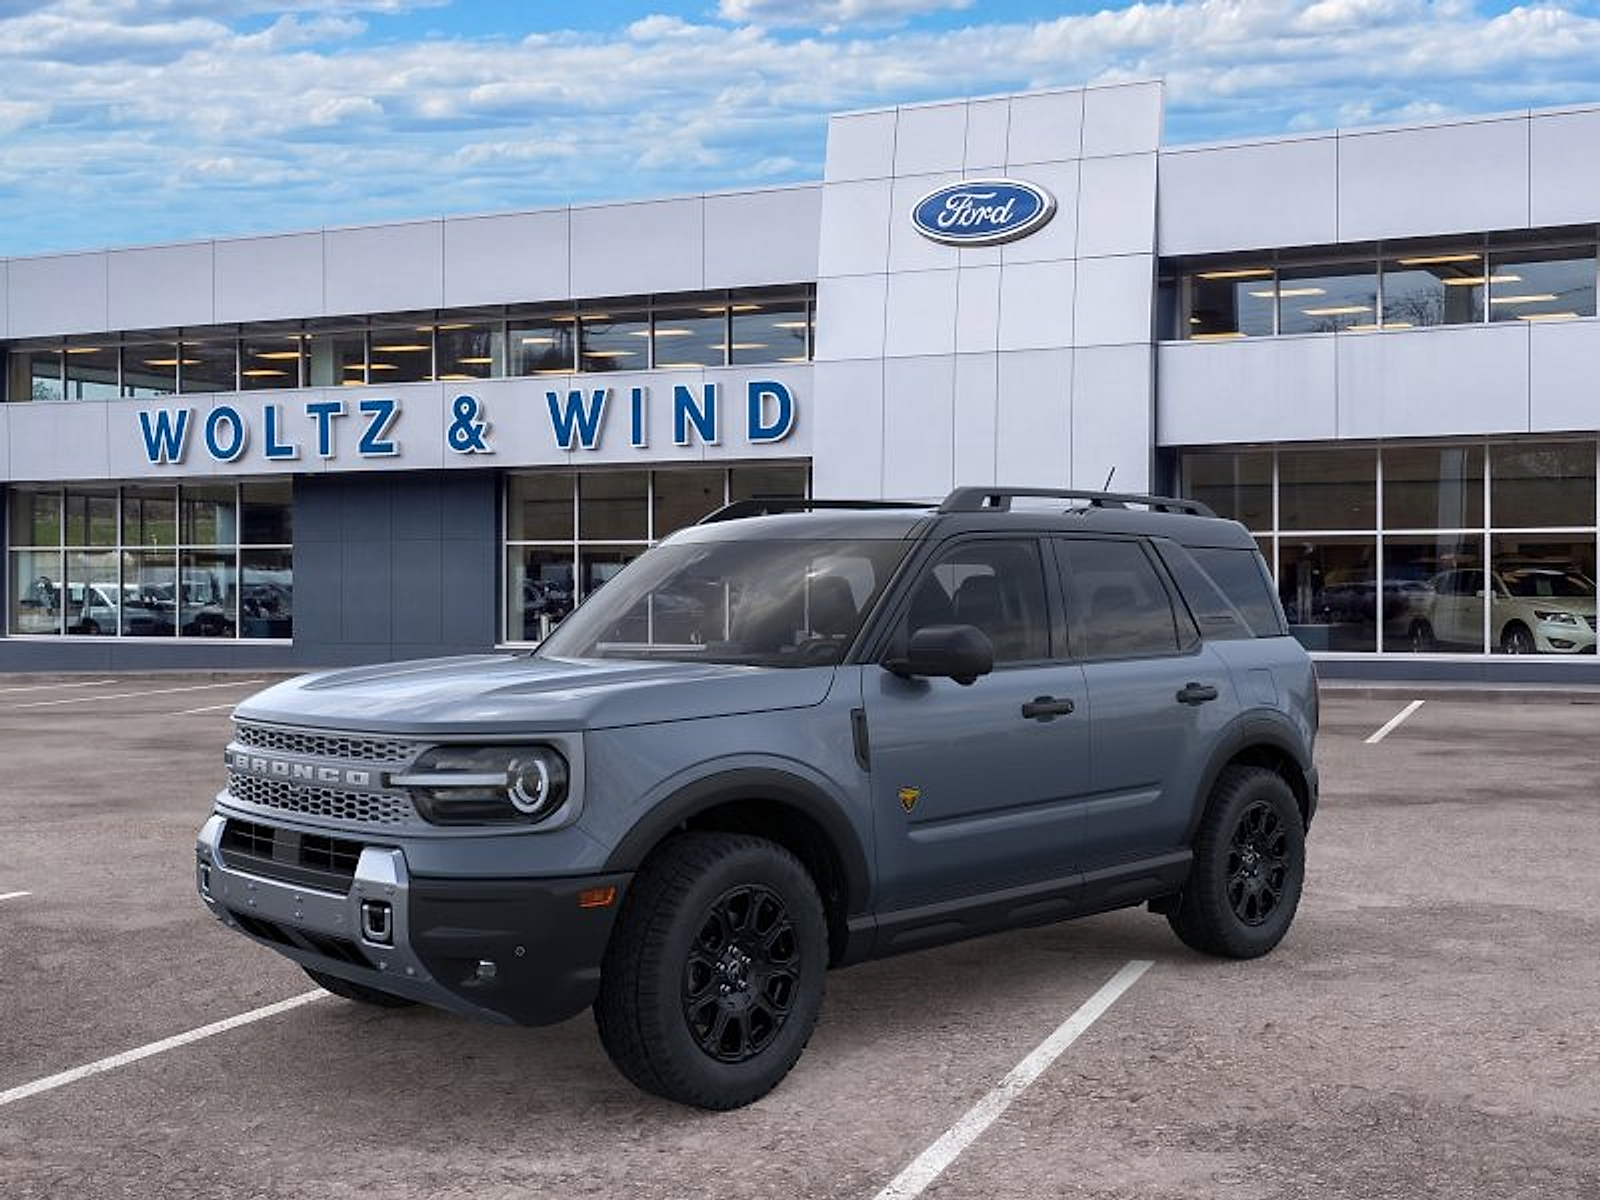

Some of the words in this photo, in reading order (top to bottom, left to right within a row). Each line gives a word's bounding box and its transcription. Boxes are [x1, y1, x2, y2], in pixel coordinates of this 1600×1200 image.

[938, 192, 1015, 227] Ford
[138, 398, 402, 464] WOLTZ
[446, 394, 493, 454] &
[545, 380, 796, 451] WIND
[235, 755, 370, 786] BRONCO
